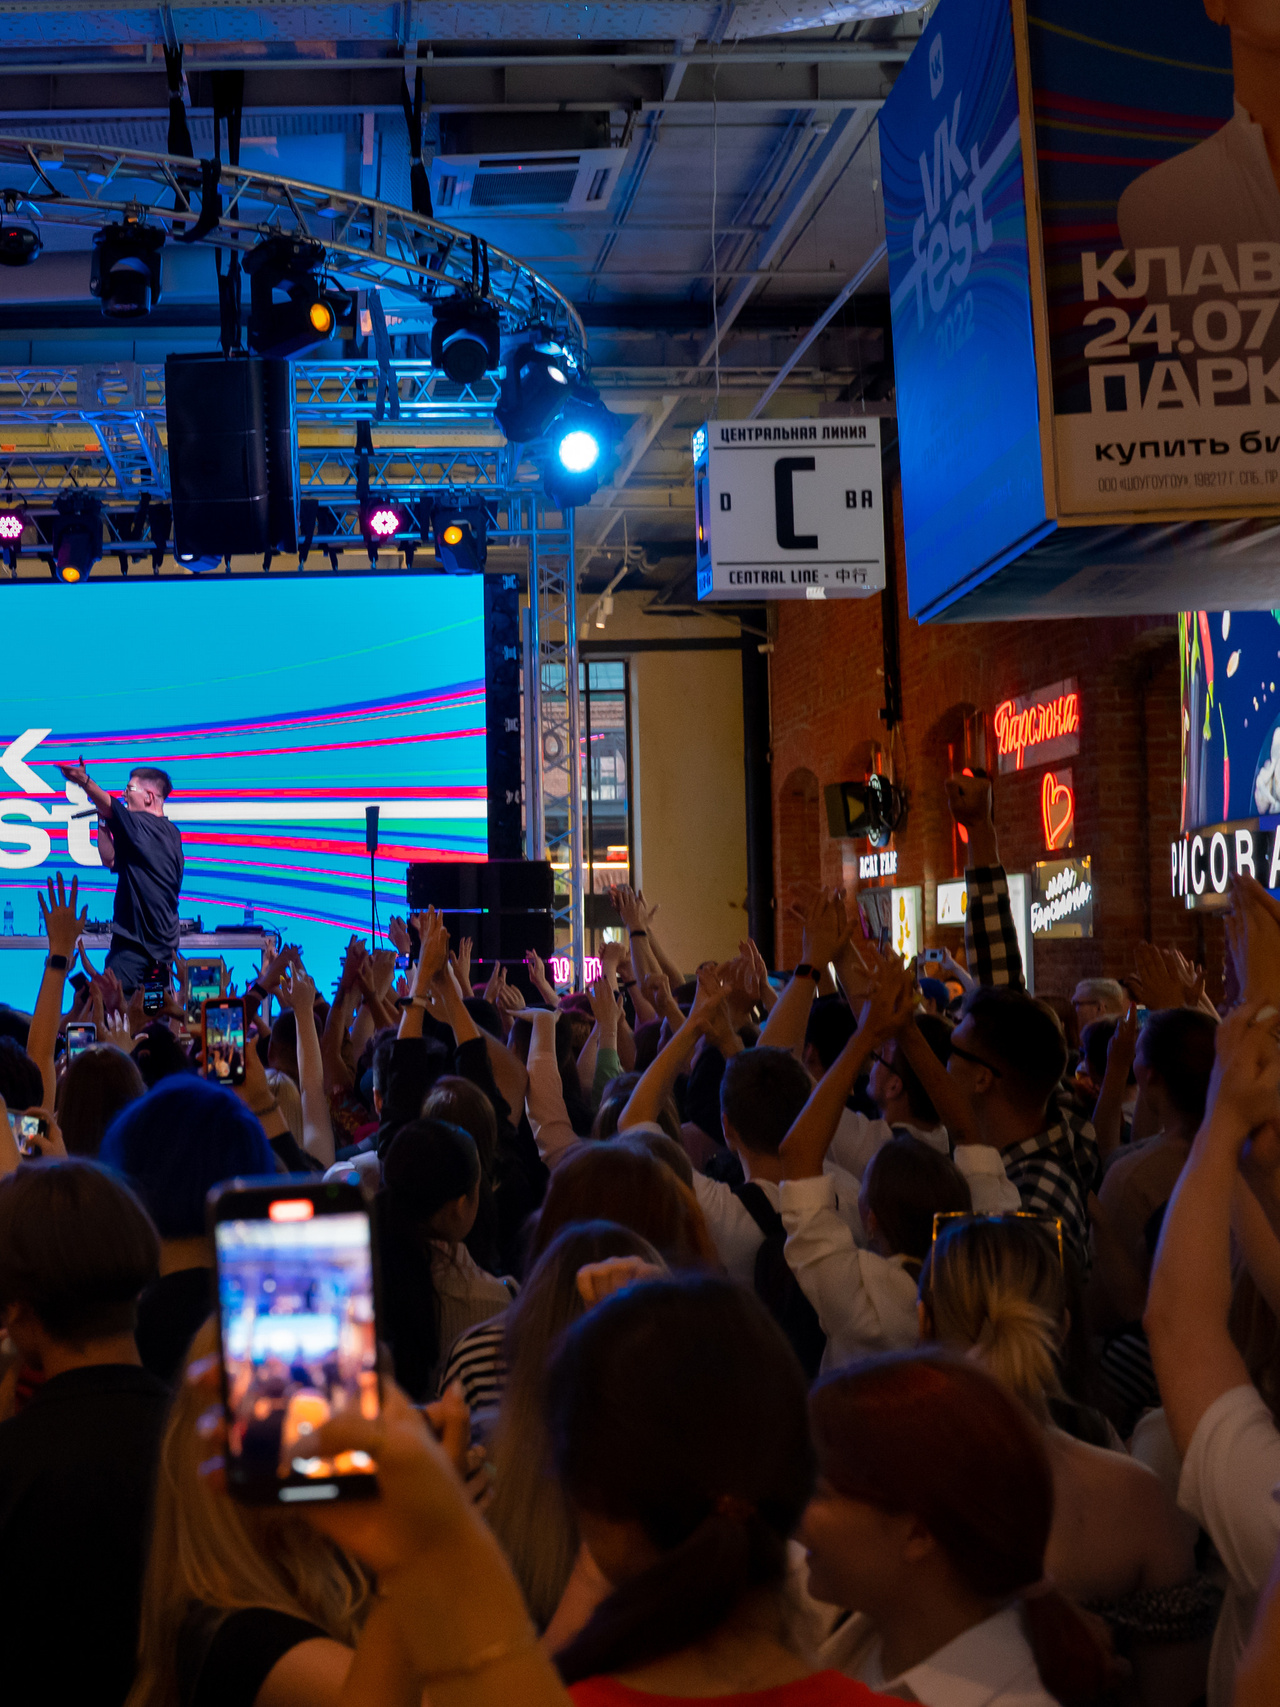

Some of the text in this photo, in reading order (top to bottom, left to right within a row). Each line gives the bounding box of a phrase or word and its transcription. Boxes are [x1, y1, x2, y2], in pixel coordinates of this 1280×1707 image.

[919, 91, 969, 224] VK
[911, 142, 994, 332] fest
[1082, 298, 1280, 358] 24.07
[721, 425, 867, 443] ЦЕНТРАЛЬНАЯ ЛИНИЯ
[1095, 438, 1230, 466] купить
[774, 457, 818, 550] C
[729, 570, 786, 584] CENTRAL
[791, 569, 819, 584] LINE
